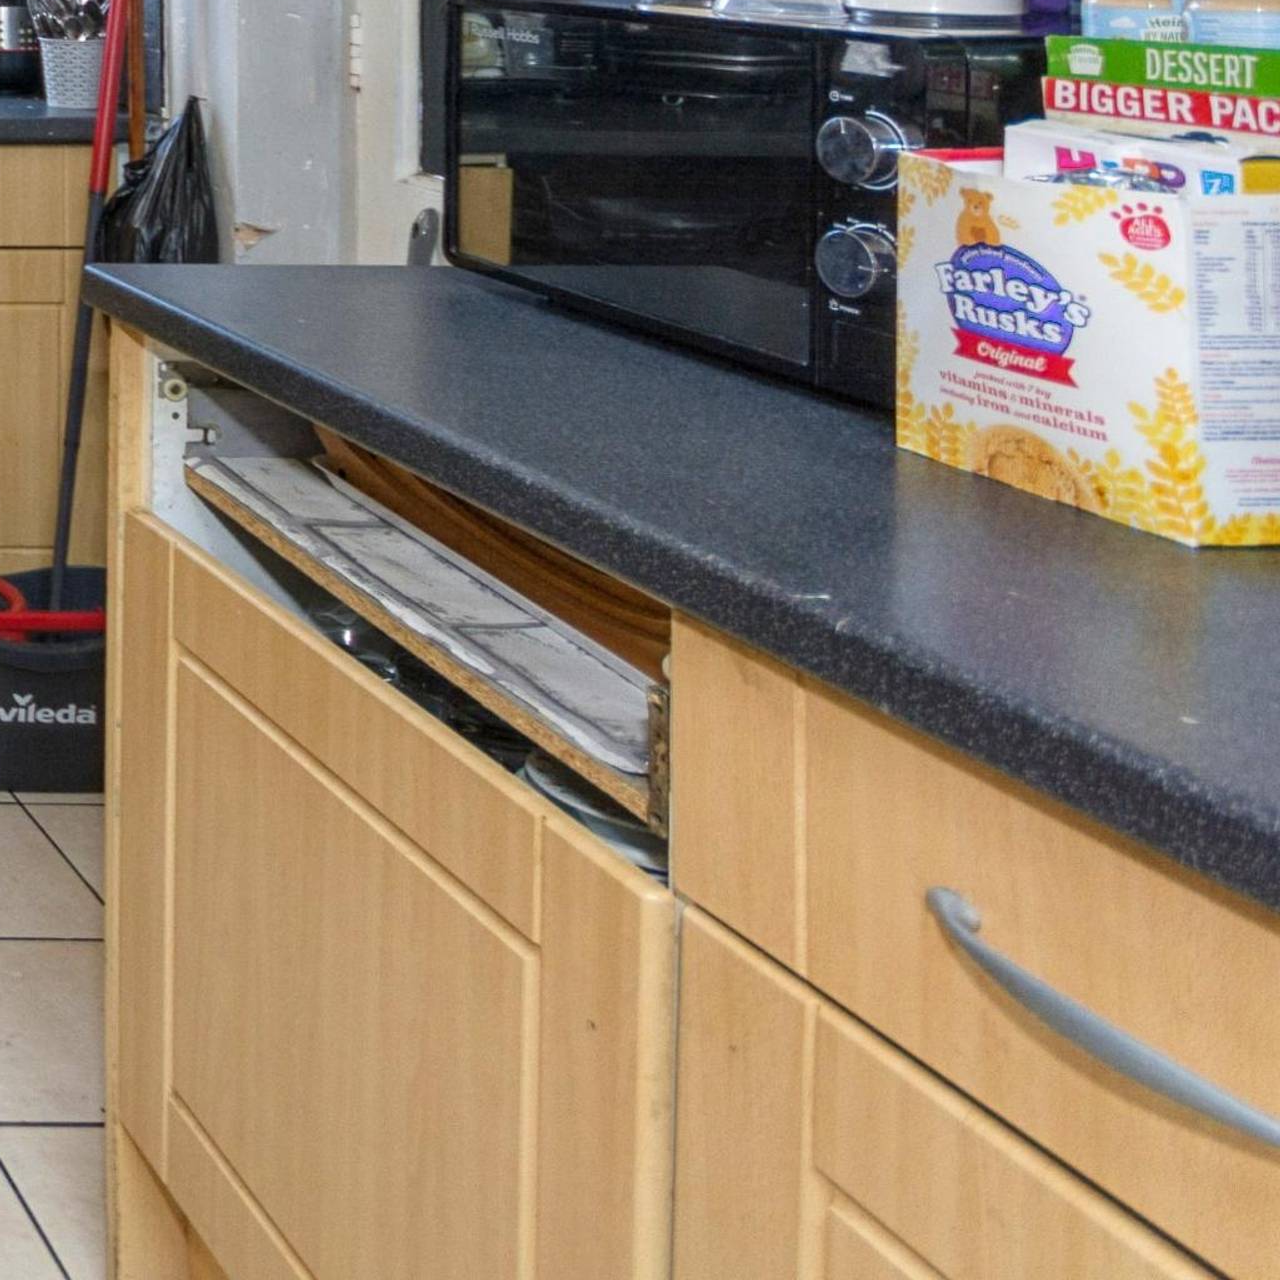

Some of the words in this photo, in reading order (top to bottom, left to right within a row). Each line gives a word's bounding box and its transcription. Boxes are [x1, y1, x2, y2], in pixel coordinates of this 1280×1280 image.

[507, 28, 540, 44] Hobbs
[1145, 48, 1259, 89] DESSERT
[1054, 79, 1194, 124] BIGGER
[935, 262, 1091, 328] Farley's
[953, 293, 1063, 344] Rusks
[976, 340, 1047, 372] Original
[939, 370, 1007, 400] vitamins
[1019, 395, 1105, 426] minerals
[976, 394, 1010, 415] iron
[1032, 413, 1109, 443] calcium
